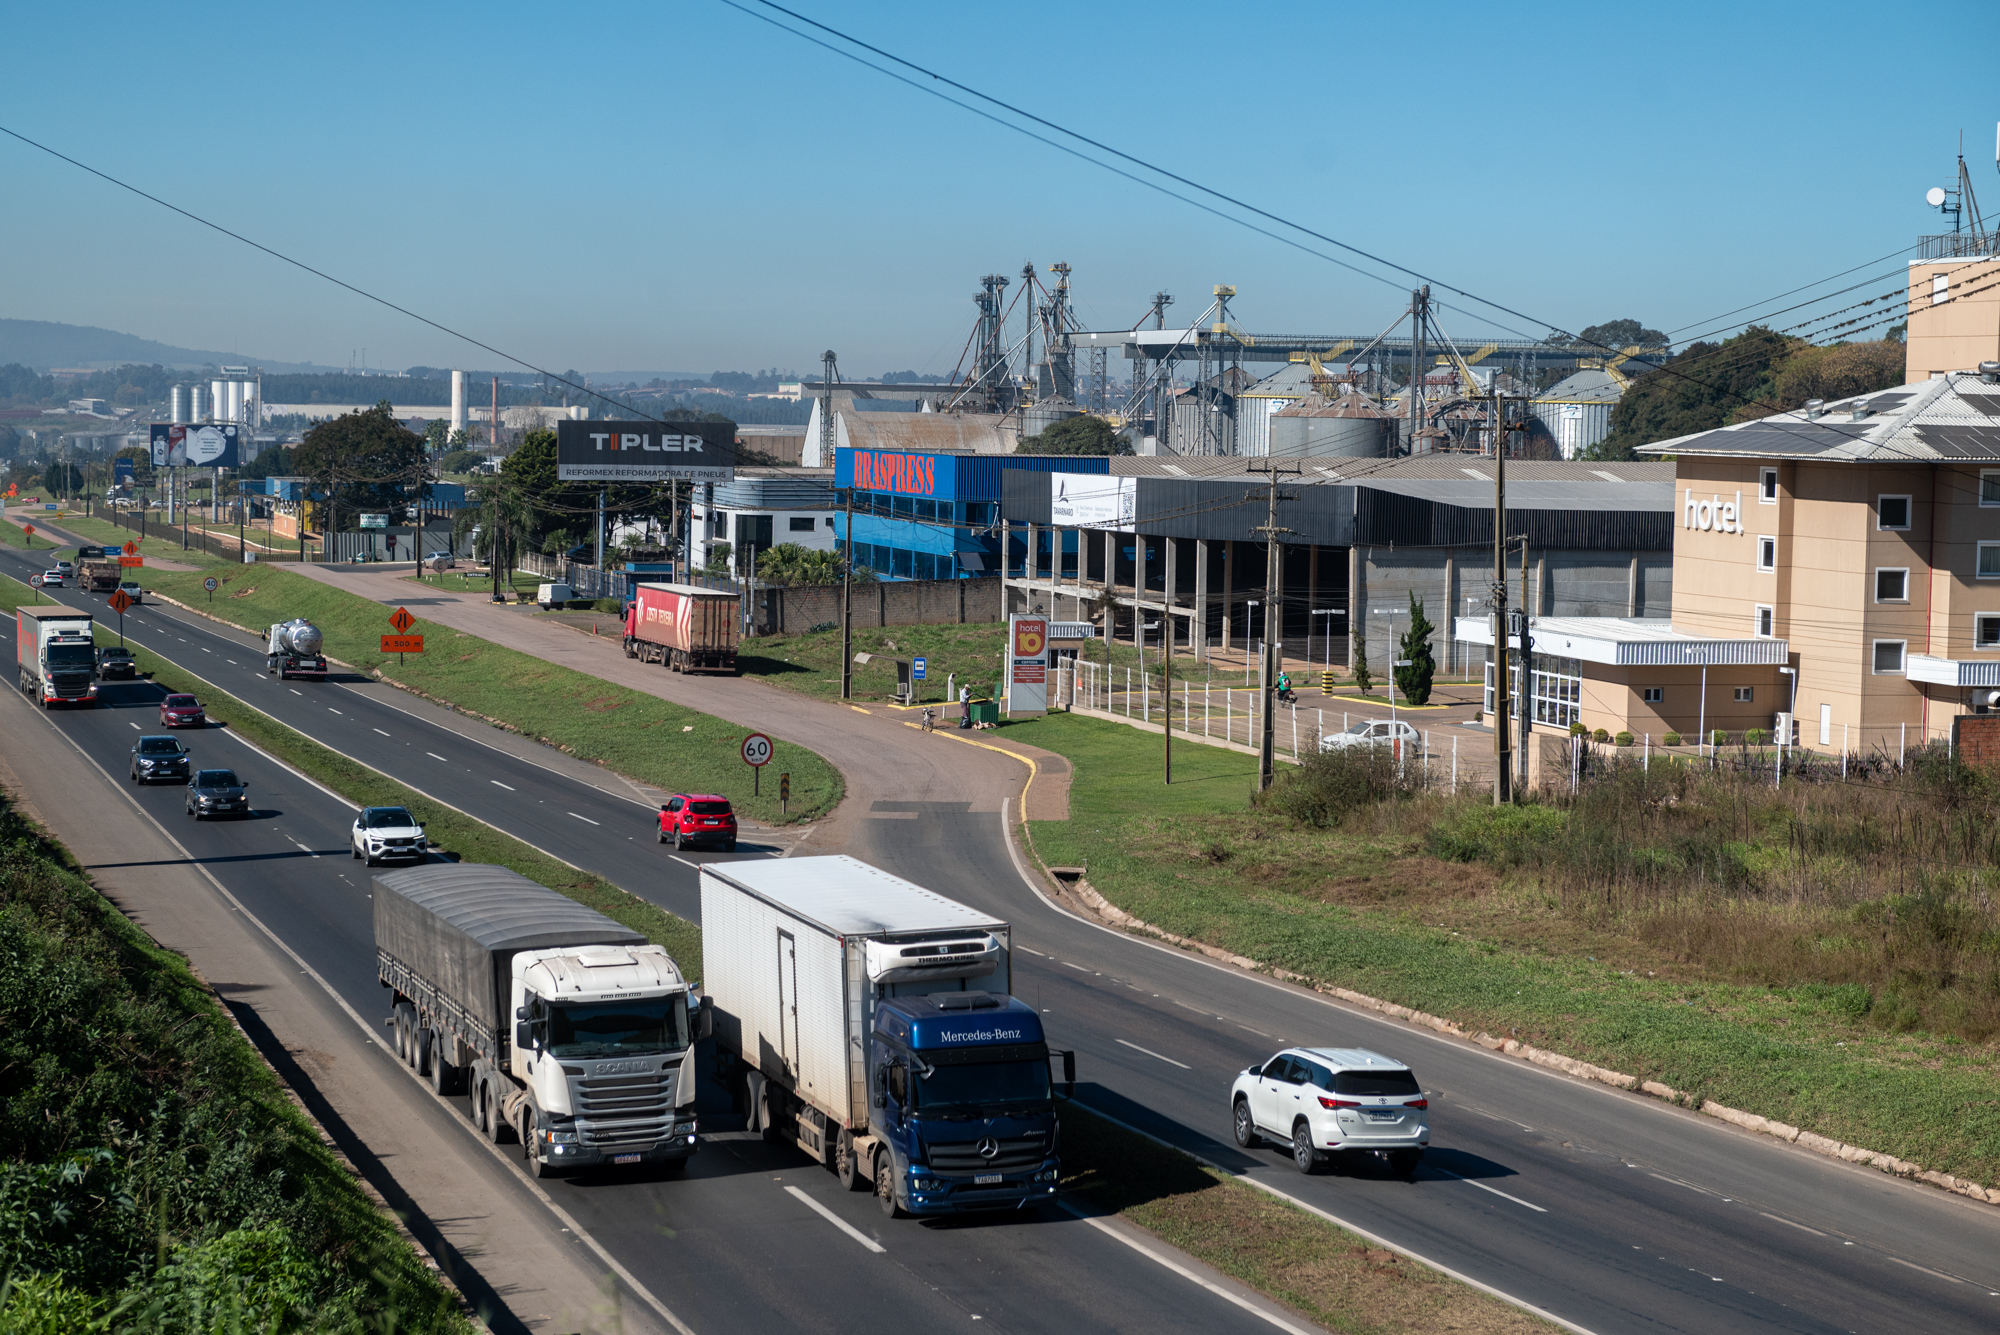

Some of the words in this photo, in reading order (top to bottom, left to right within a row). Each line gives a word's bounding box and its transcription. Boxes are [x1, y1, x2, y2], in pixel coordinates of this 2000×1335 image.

[589, 433, 704, 453] TIPLER
[566, 468, 614, 476] REFORMEX
[615, 469, 682, 477] REFORMADORA
[684, 470, 696, 478] DE
[697, 470, 726, 478] PNEUS
[853, 450, 935, 495] BRASPRESS
[1684, 488, 1745, 536] hotel
[32, 576, 42, 584] 40
[205, 580, 216, 588] 40
[646, 606, 658, 623] COSTA
[658, 608, 674, 627] TEIXEIRA
[1020, 624, 1041, 632] hotel
[1018, 633, 1041, 653] 10
[746, 742, 768, 756] 60
[917, 956, 953, 964] THERMO
[954, 954, 976, 962] KING
[941, 1028, 1022, 1043] Mercedes-Benz
[595, 1060, 652, 1074] SCANIA
